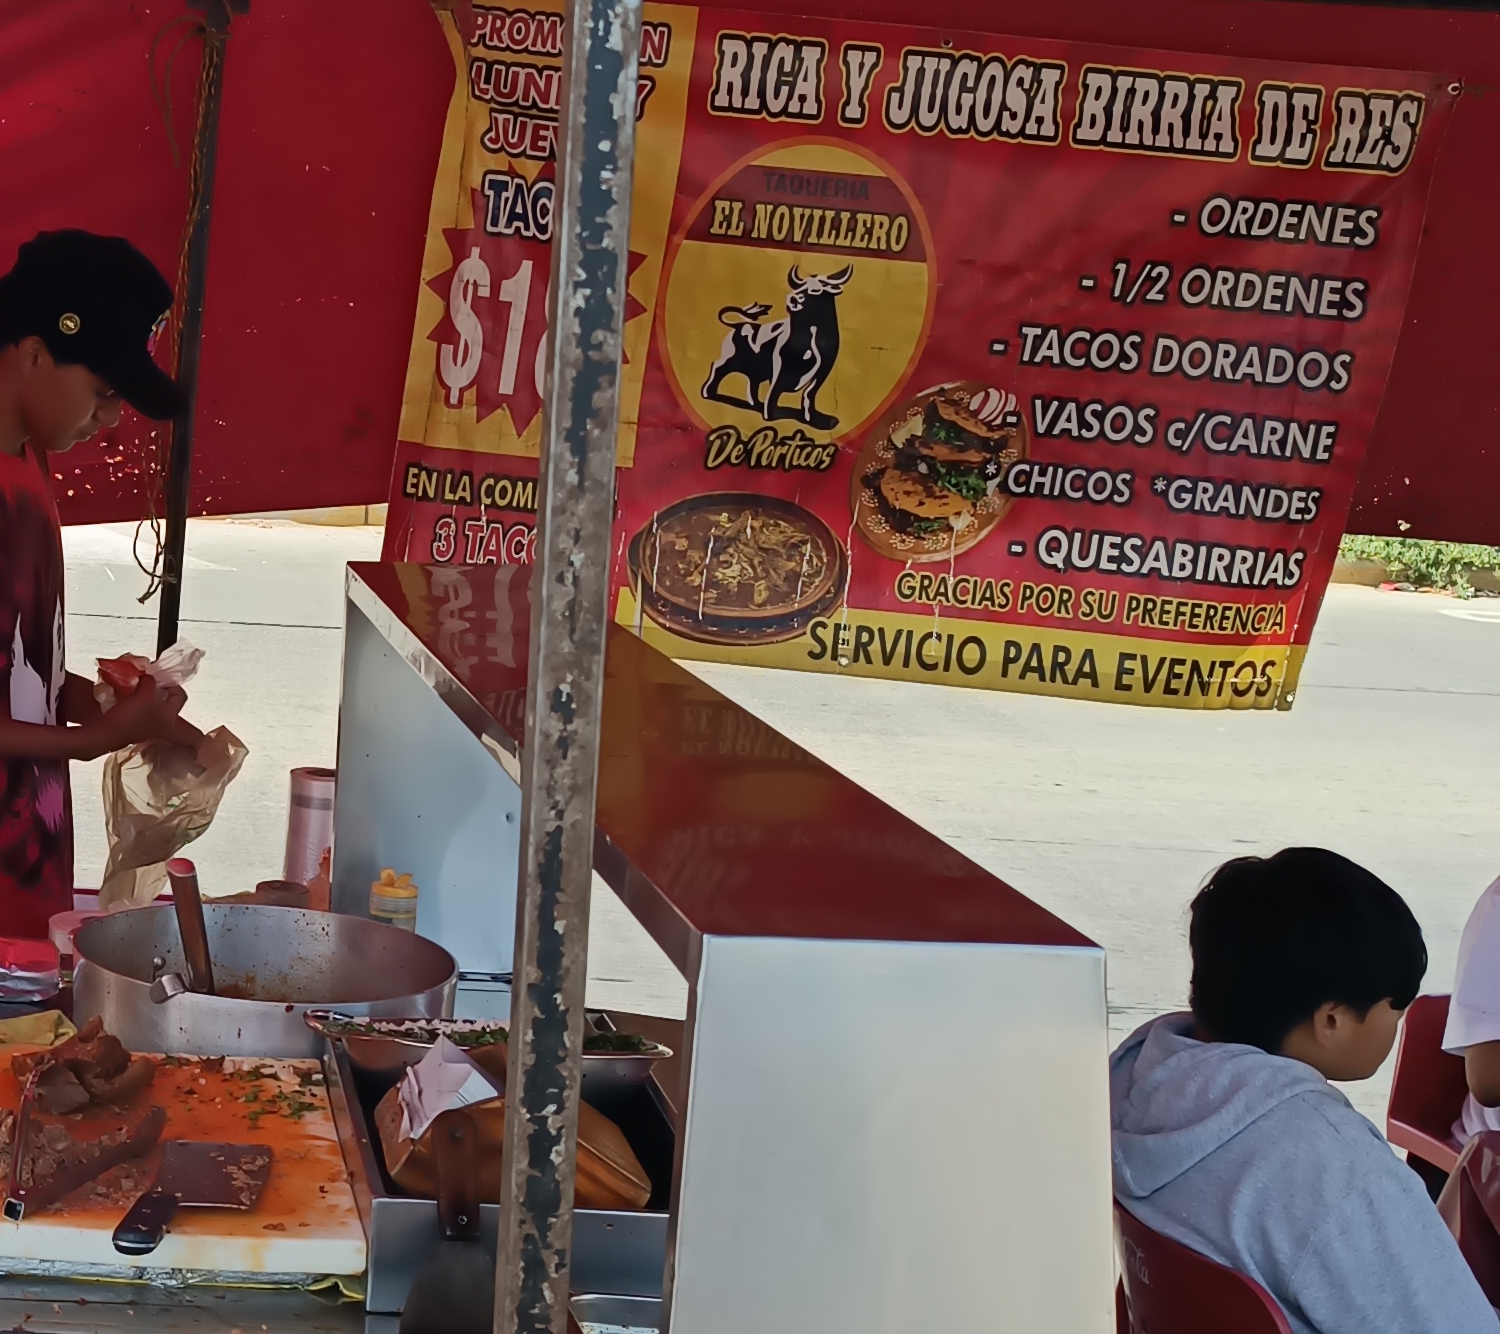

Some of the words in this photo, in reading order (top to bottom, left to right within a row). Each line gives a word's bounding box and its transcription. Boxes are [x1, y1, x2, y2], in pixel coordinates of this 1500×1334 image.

[712, 37, 824, 117] RICA
[844, 48, 879, 120] Y
[888, 53, 1062, 139] JUGOSA
[1074, 71, 1239, 155] BIRRIA
[1253, 88, 1320, 162] DE
[1327, 94, 1420, 170] RES
[484, 173, 556, 240] TAC
[763, 172, 871, 202] TAQUERIA
[709, 199, 746, 237] EL
[751, 203, 910, 253] NOVILLERO
[1199, 195, 1379, 248] ORDENES
[1112, 261, 1171, 303] 1/2
[1180, 267, 1367, 320] ORDENES
[439, 246, 550, 405] $1
[1020, 325, 1143, 371] TACOS
[1152, 336, 1352, 391] DORADOS
[706, 428, 746, 468] De
[1034, 398, 1157, 445] VASOS
[1166, 411, 1338, 461] c/CARNE
[406, 466, 438, 498] EN
[444, 473, 472, 503] LA
[431, 517, 456, 563] 3
[464, 520, 538, 565] TAC
[1037, 529, 1306, 586] QUESABIRRIAS
[896, 571, 1013, 611] GRACIAS
[1018, 584, 1073, 616] POR
[1081, 589, 1119, 621] SU
[1125, 595, 1286, 634] PREFERENCIA
[806, 620, 987, 676] SERVICIO
[1000, 639, 1100, 689] PARA
[1113, 651, 1277, 699] EVENTOS
